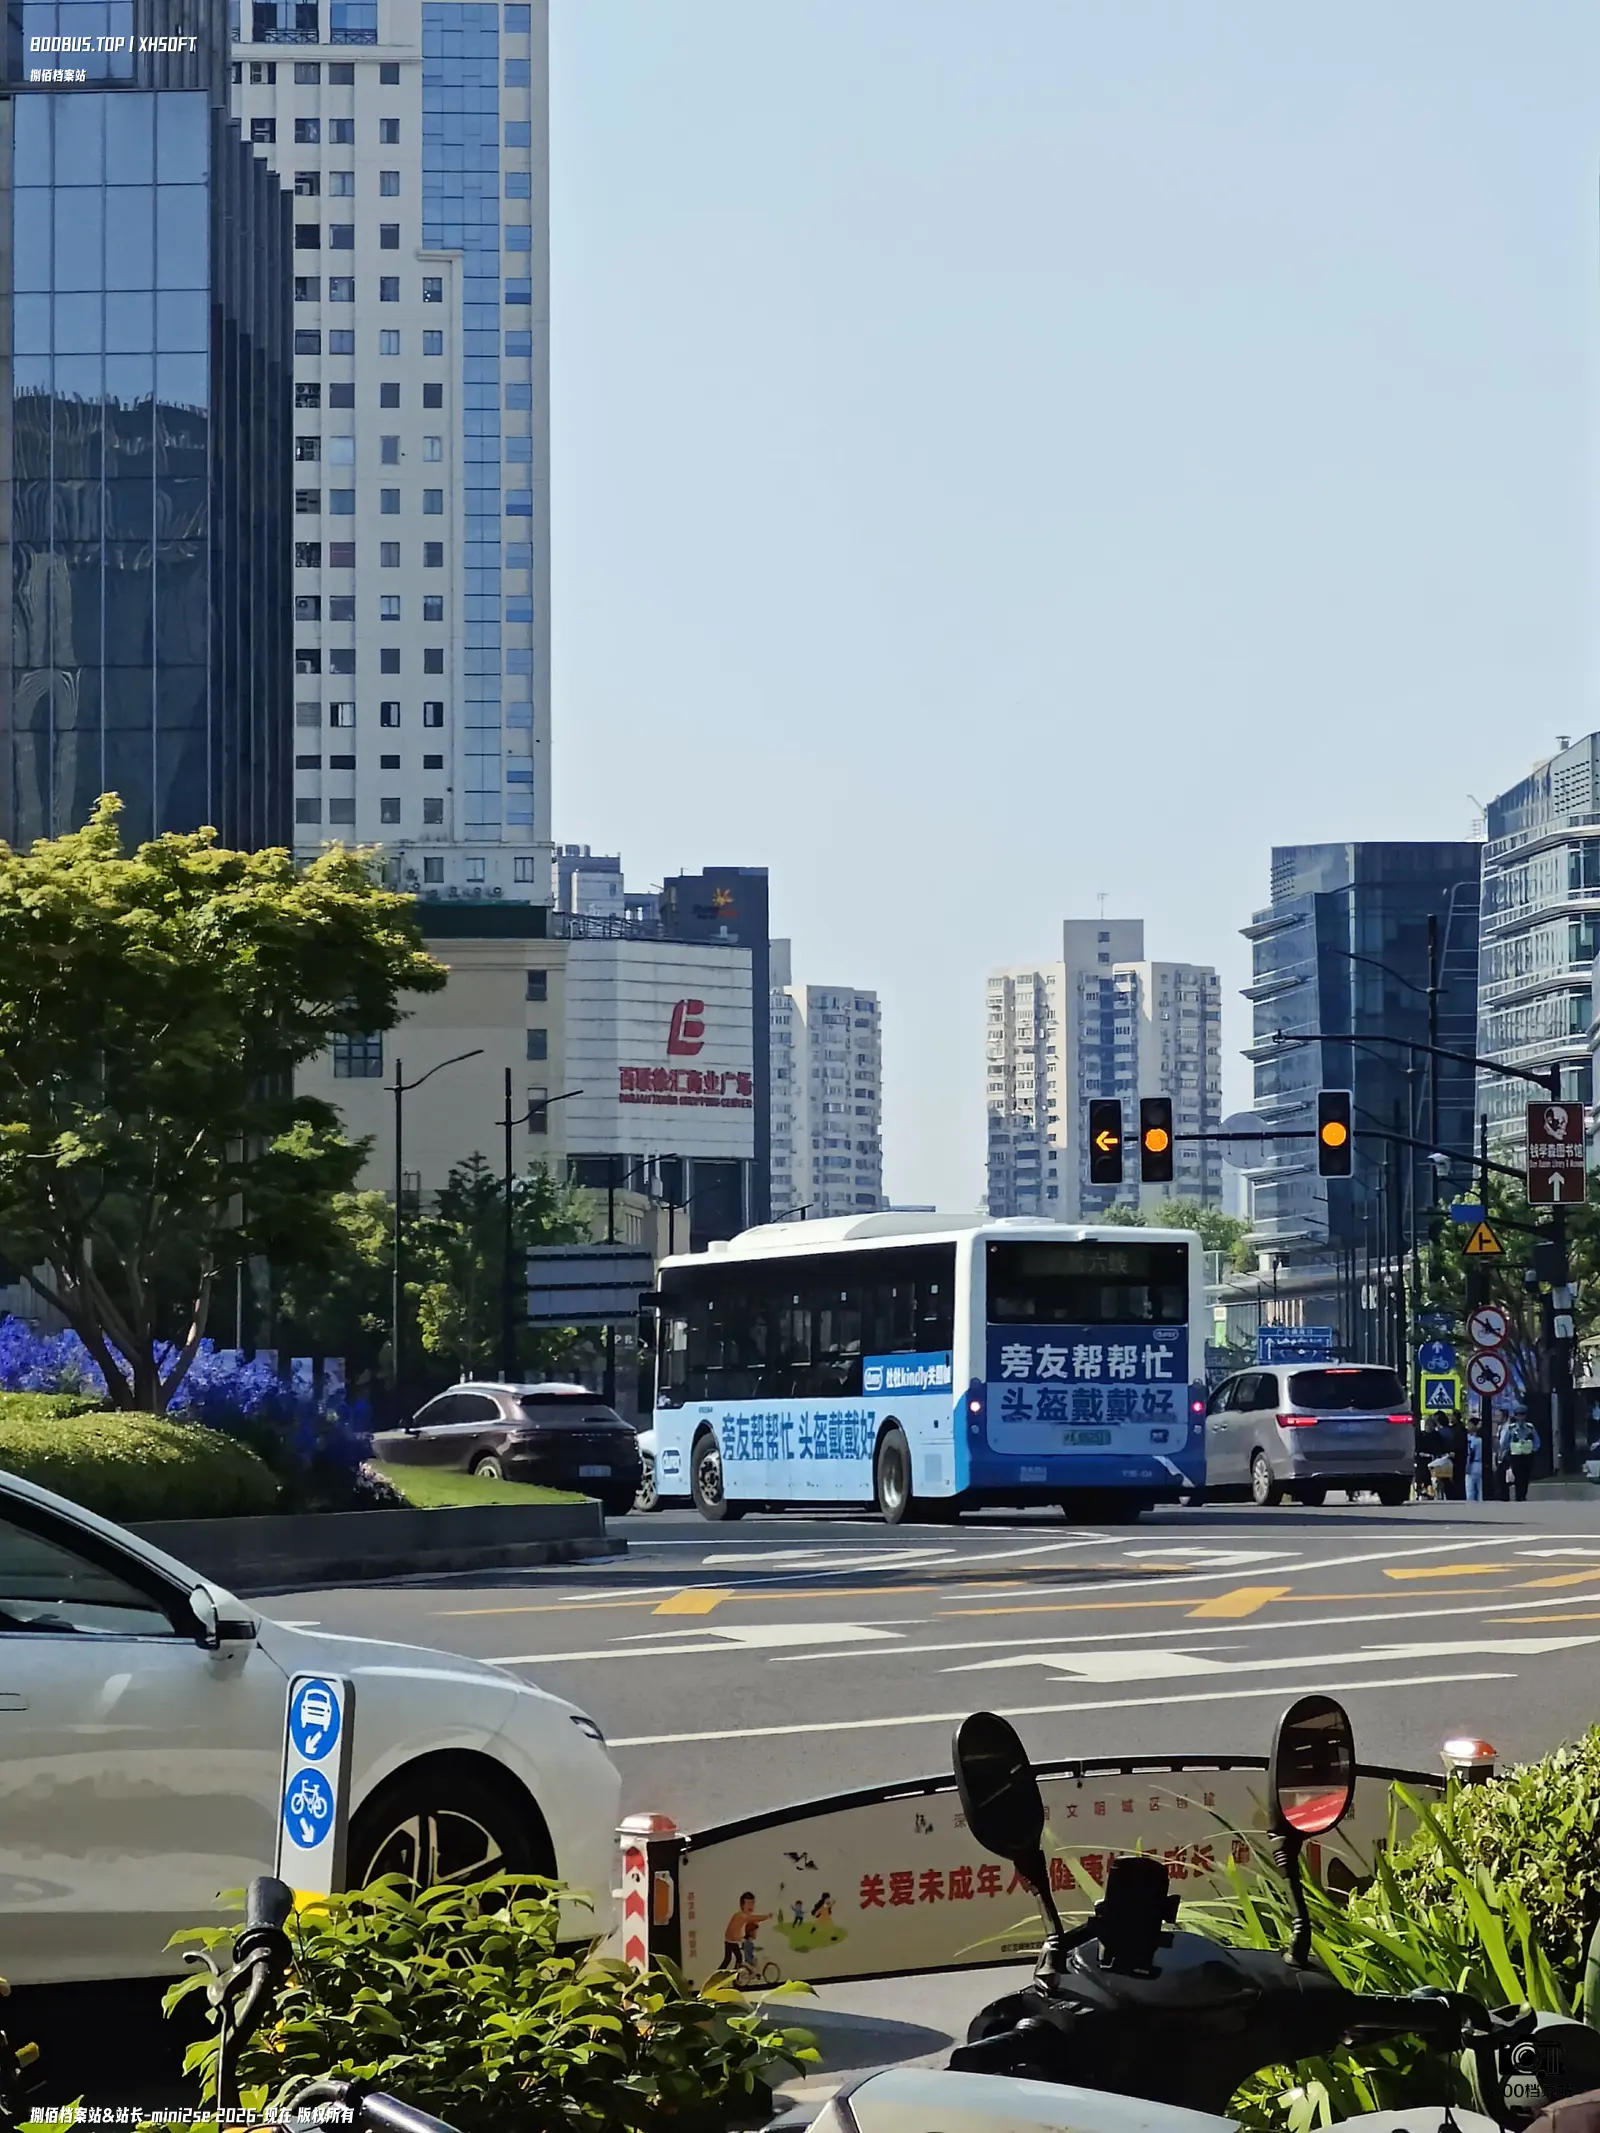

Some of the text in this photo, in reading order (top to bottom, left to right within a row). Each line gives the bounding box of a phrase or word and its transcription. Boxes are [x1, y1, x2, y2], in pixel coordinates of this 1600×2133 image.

[1000, 1343, 1174, 1379] 旁友帮帮忙
[1000, 1386, 1174, 1423] 头盔戴戴好
[722, 1411, 794, 1462] 旁友帮帮忙
[798, 1409, 876, 1461] 头盔戴戴好
